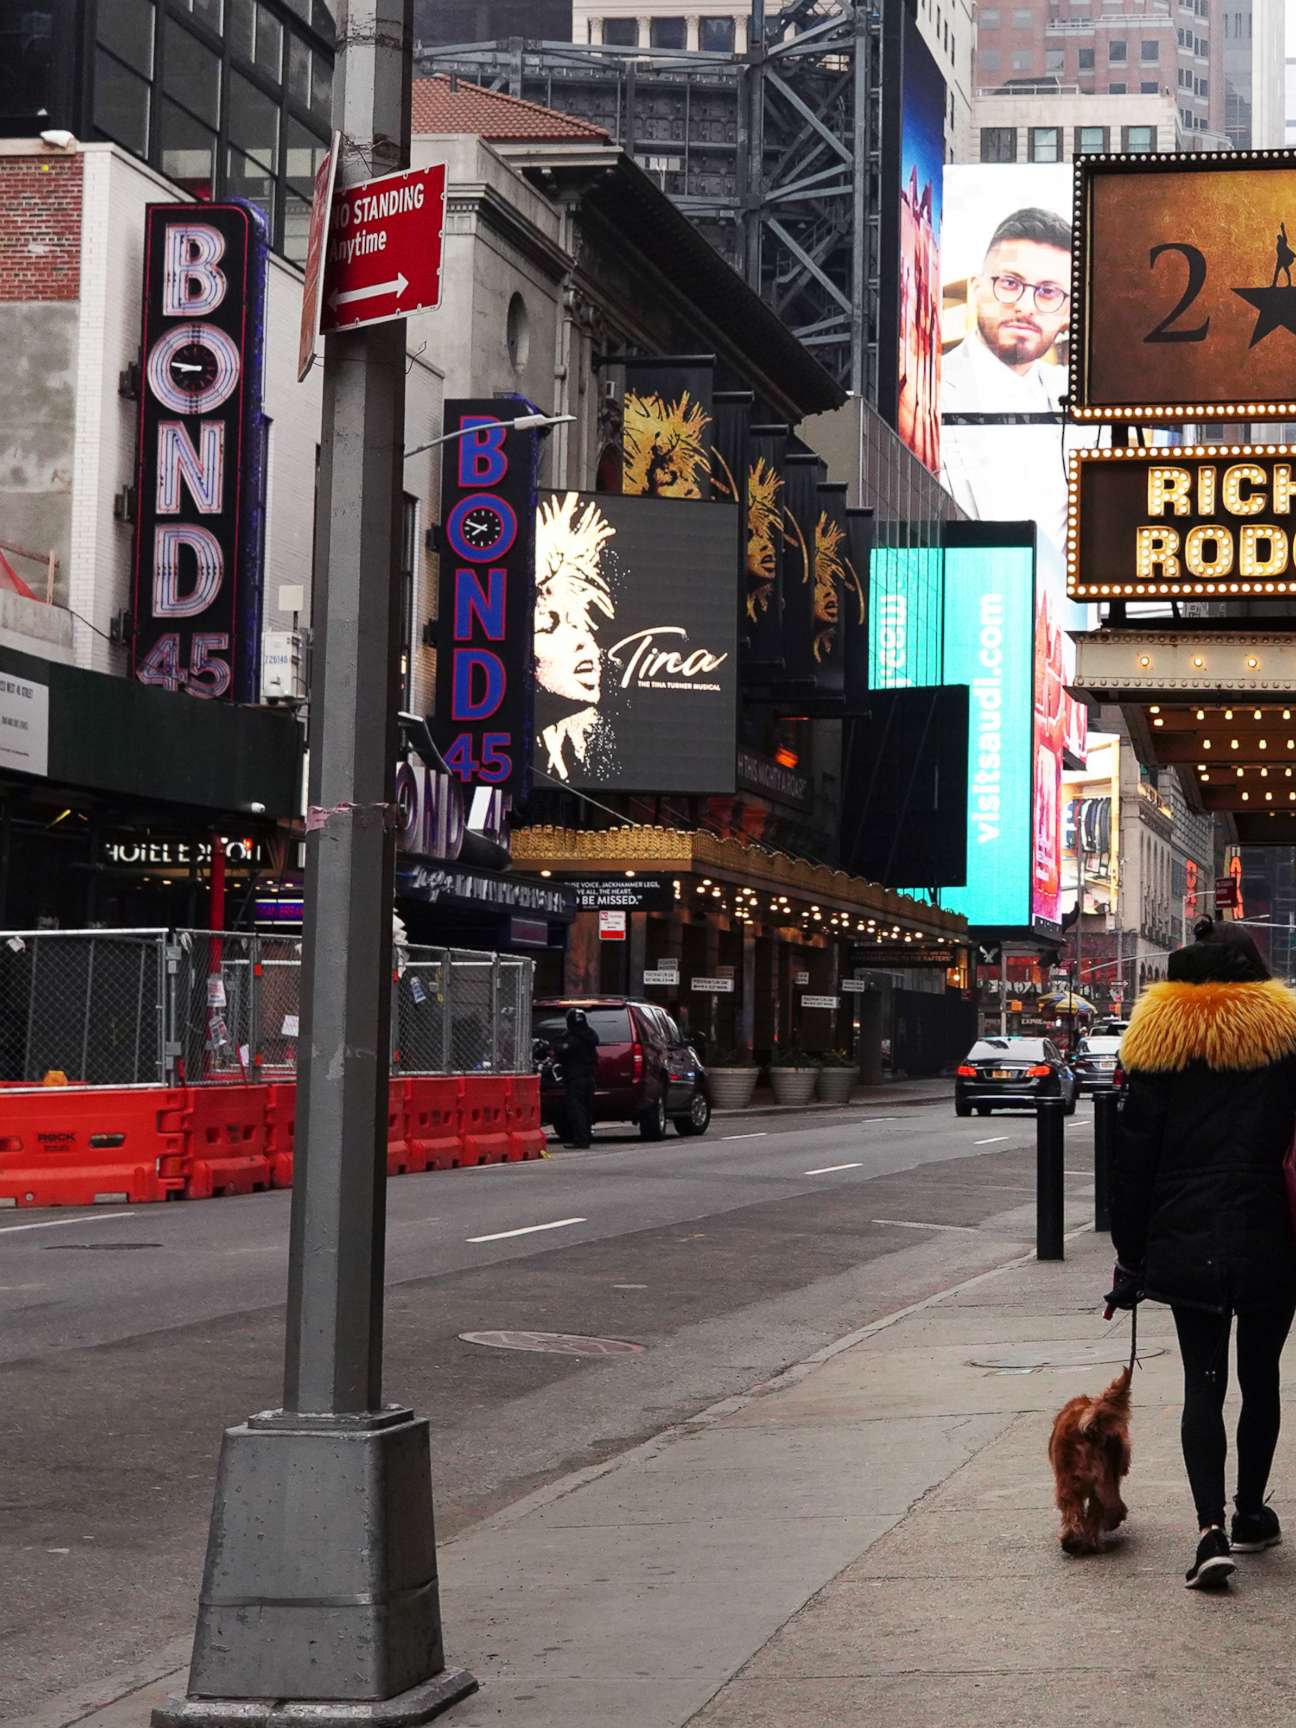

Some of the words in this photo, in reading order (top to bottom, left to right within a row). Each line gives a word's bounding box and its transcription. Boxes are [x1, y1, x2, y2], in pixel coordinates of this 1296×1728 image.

[353, 183, 424, 225] STANDING
[329, 229, 387, 265] Anytime
[147, 222, 241, 619] BOND
[446, 415, 517, 724] BOND
[136, 633, 232, 699] 45
[607, 625, 728, 689] Tina
[443, 731, 512, 784] 45
[581, 895, 595, 905] BE
